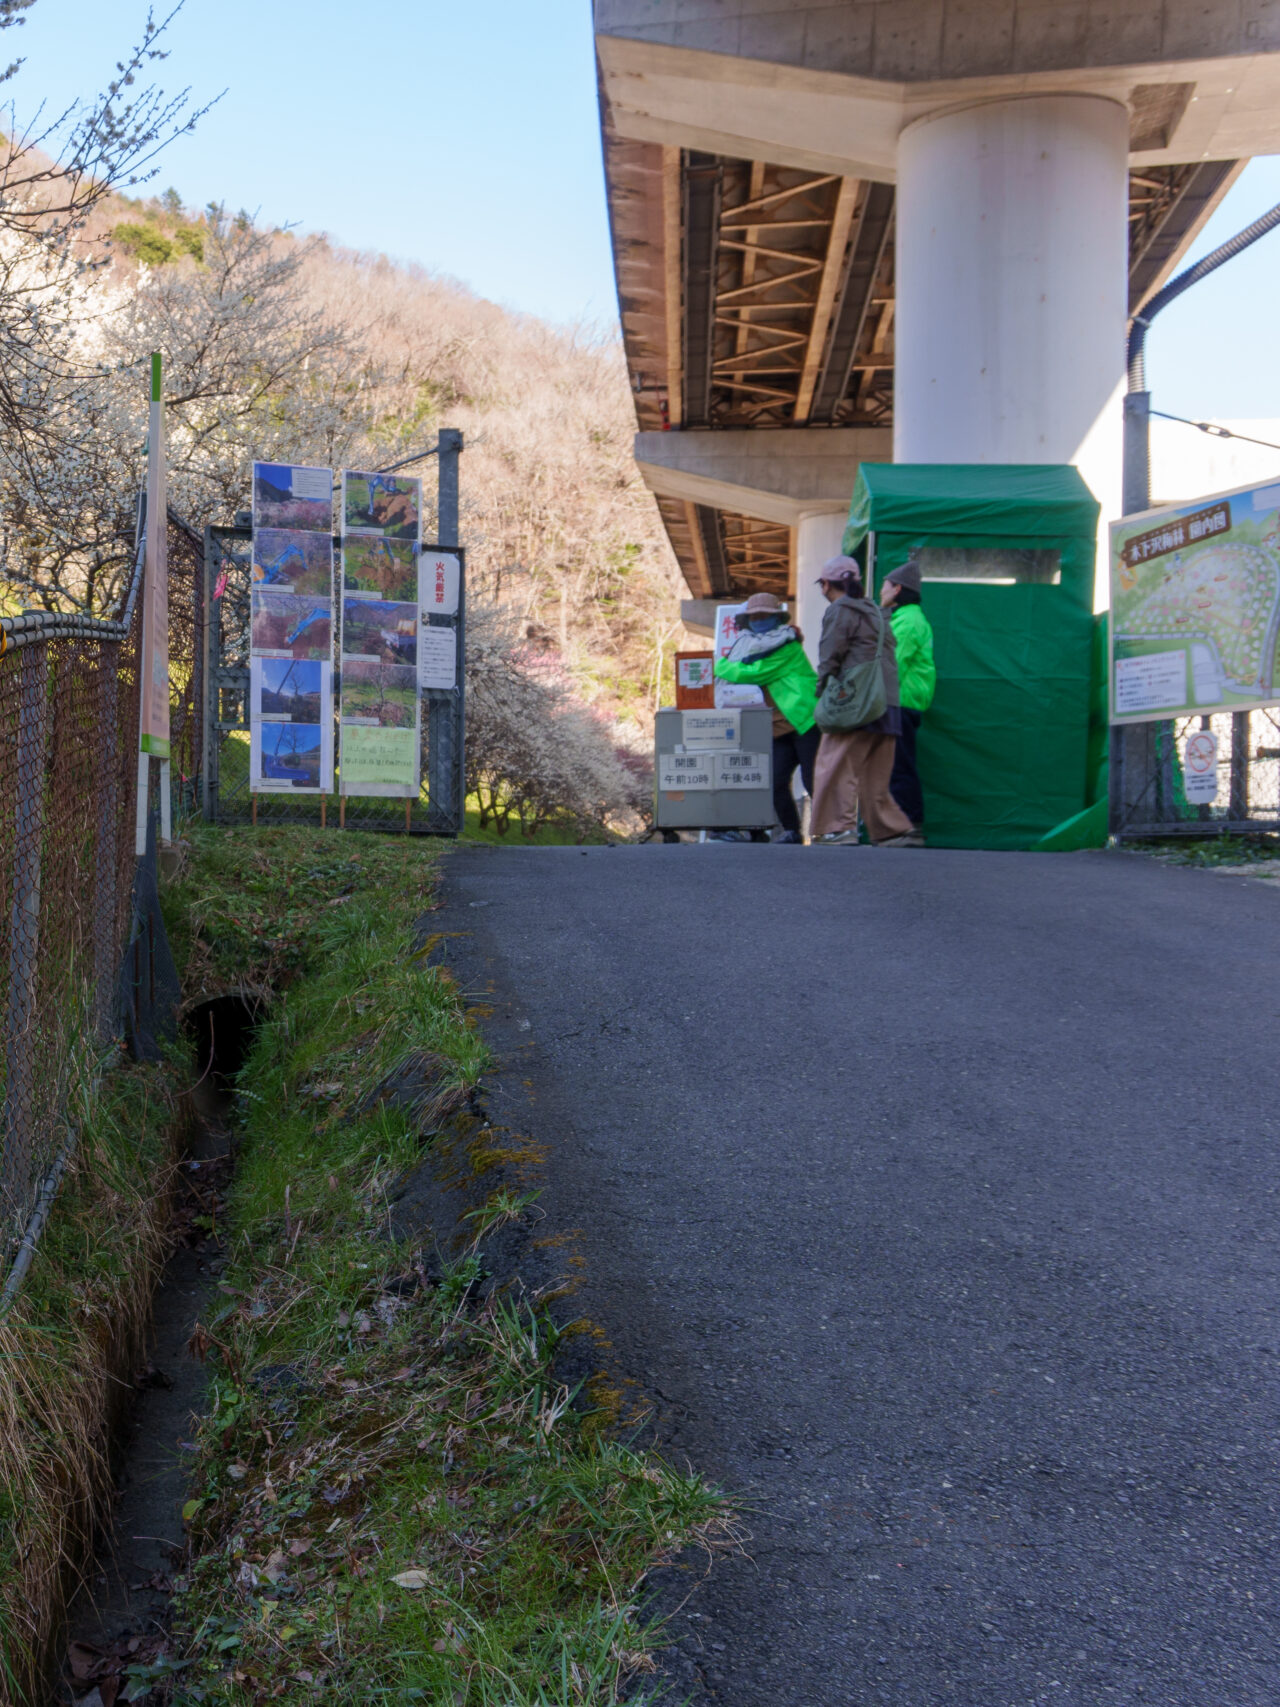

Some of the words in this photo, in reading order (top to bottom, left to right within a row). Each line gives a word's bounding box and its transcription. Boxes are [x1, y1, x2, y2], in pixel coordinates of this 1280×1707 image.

[664, 775, 710, 785] 午前10時
[720, 772, 762, 784] 午後4時
